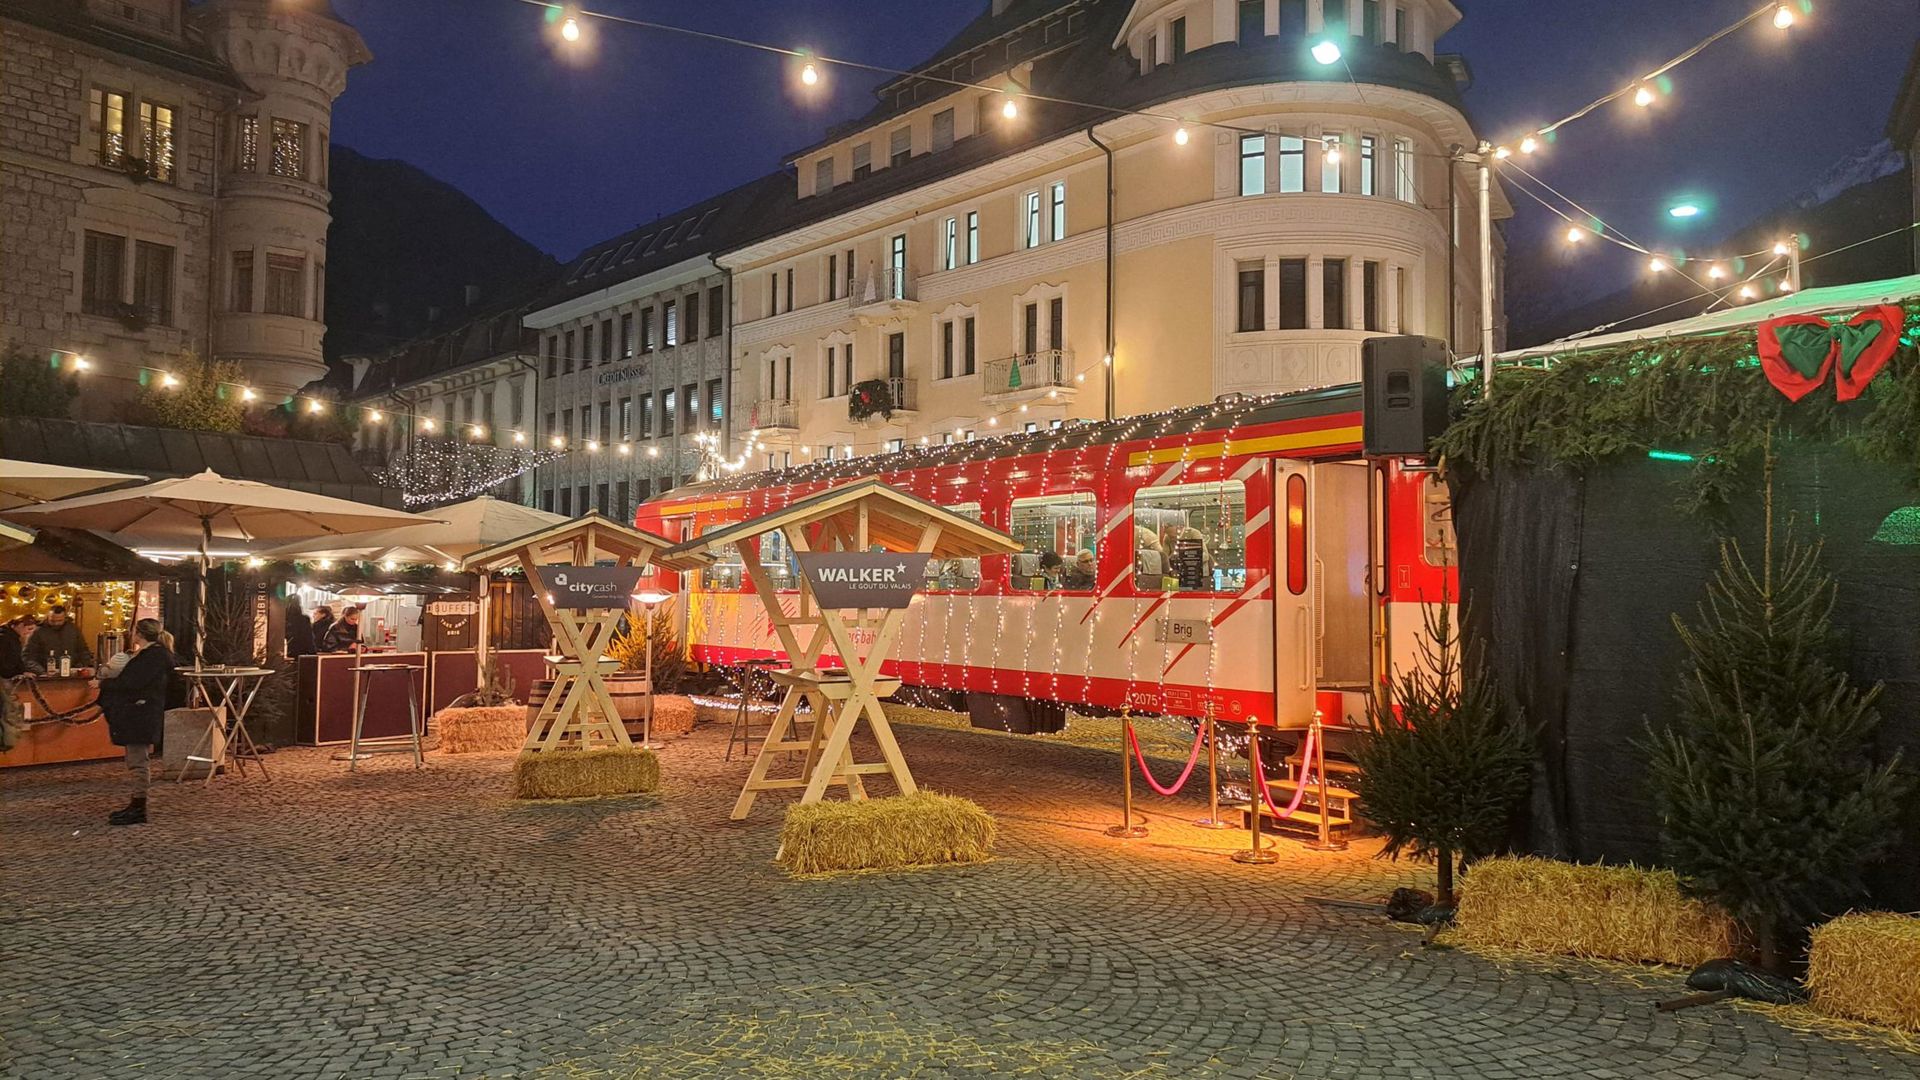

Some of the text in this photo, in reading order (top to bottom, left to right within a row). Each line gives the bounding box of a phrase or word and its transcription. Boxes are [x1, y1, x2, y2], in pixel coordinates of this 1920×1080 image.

[992, 507, 997, 527] 1
[818, 568, 896, 582] WALKER
[569, 582, 617, 594] citycash
[440, 618, 467, 629] TAKE AWAY
[1174, 623, 1192, 638] Brig
[1125, 691, 1132, 703] A
[1134, 692, 1158, 706] 2075
